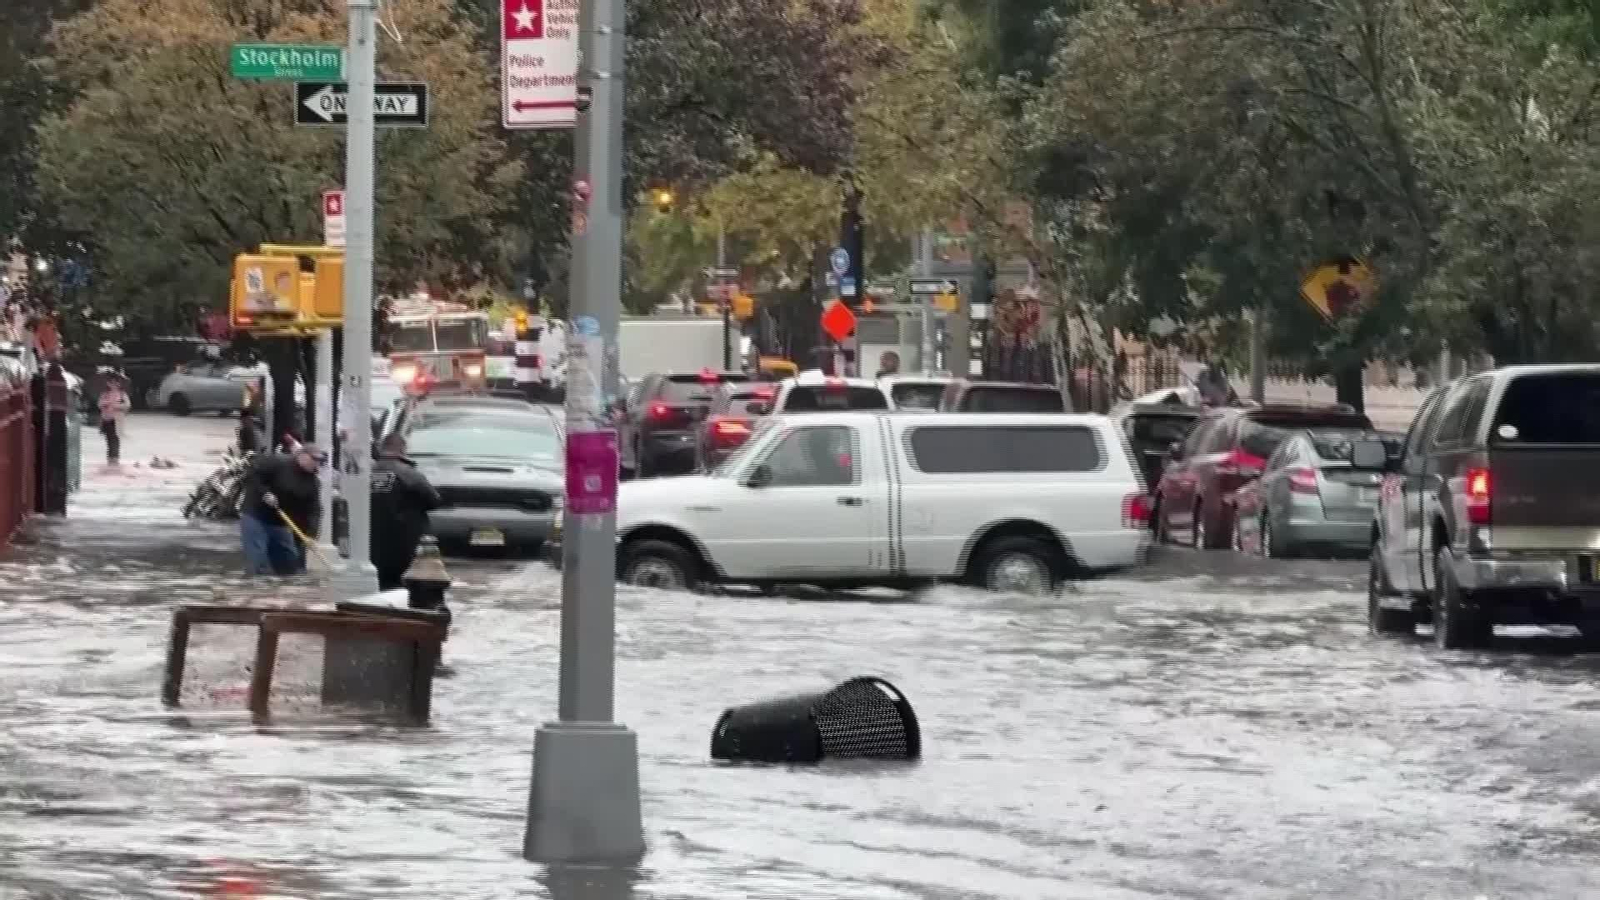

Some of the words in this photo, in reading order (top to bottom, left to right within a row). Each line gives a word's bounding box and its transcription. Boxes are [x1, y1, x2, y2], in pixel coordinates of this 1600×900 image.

[546, 27, 571, 39] Only
[239, 48, 339, 67] Stockholm
[509, 54, 545, 68] Police
[319, 95, 347, 112] ON
